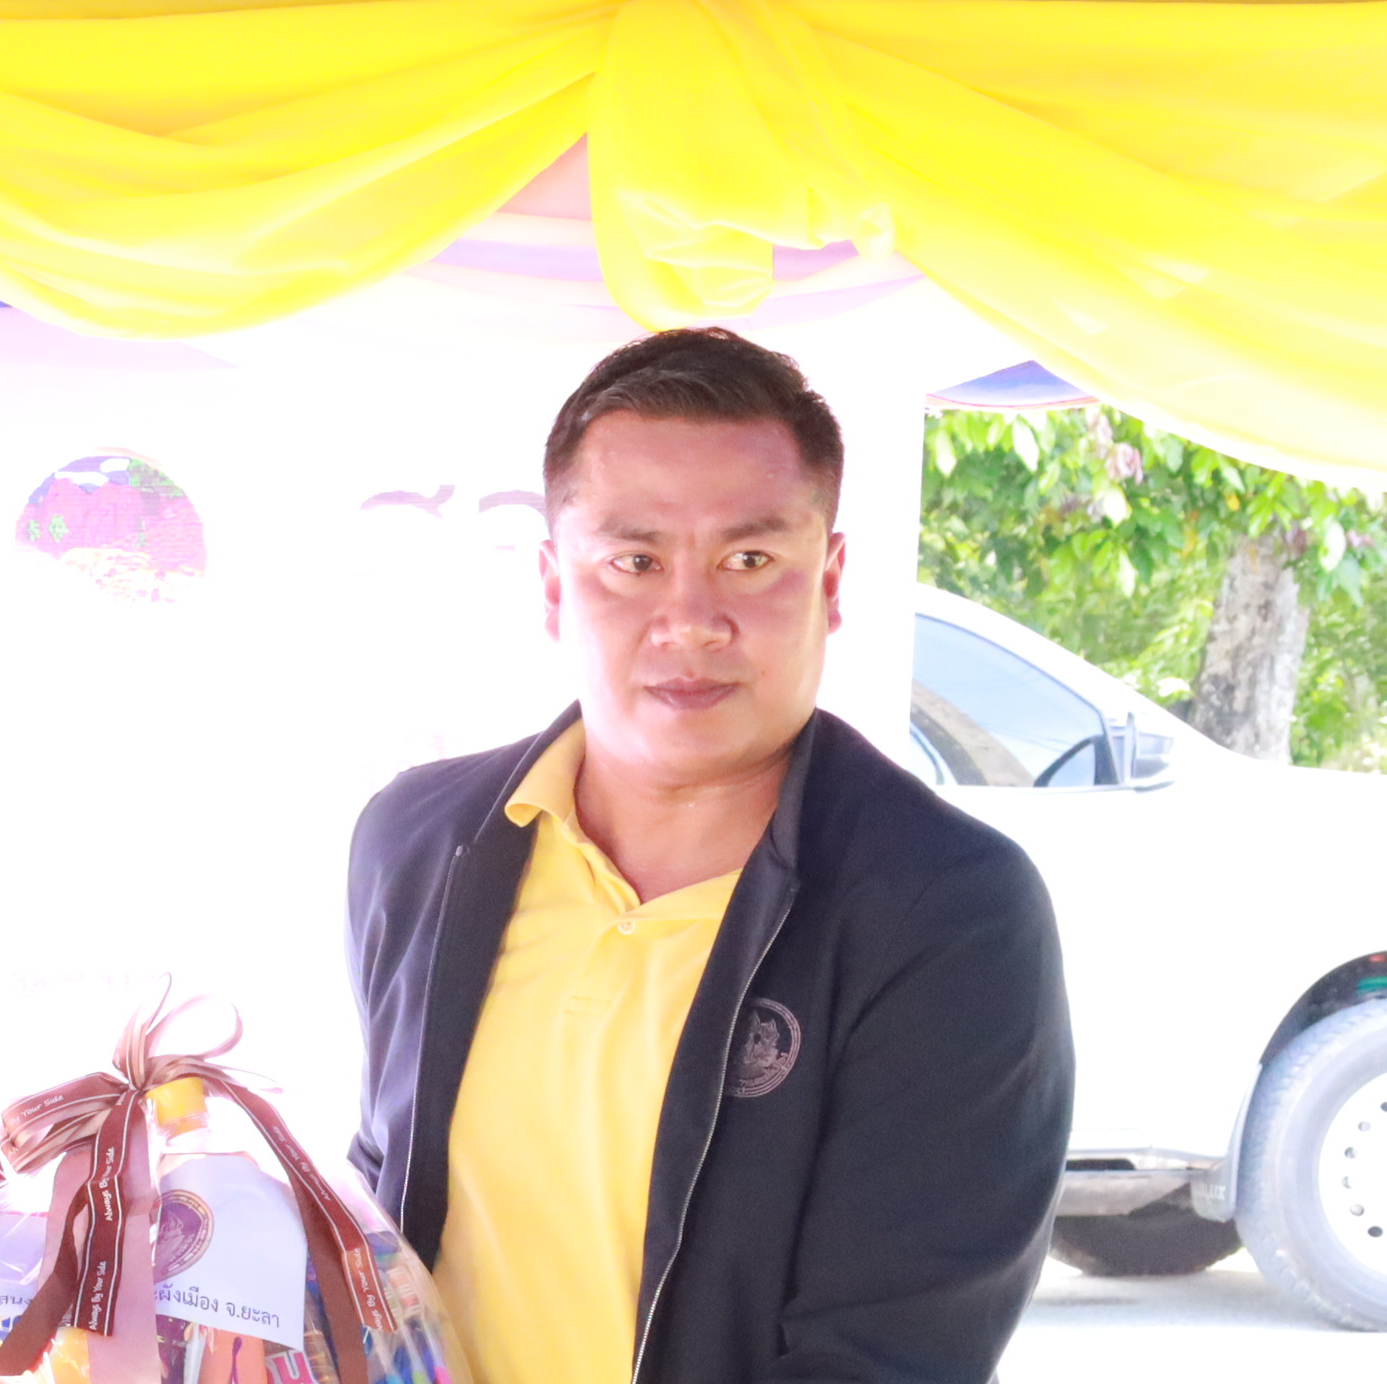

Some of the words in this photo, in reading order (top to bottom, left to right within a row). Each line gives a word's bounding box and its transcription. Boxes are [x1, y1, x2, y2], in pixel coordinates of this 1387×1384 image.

[44, 1095, 64, 1107] Side
[106, 1147, 115, 1164] Side
[104, 1190, 113, 1221] Always
[97, 1260, 107, 1276] Side
[93, 1275, 104, 1293] Your
[91, 1291, 103, 1304] By
[88, 1304, 102, 1330] Always
[226, 1301, 280, 1328] จ.ยะลา
